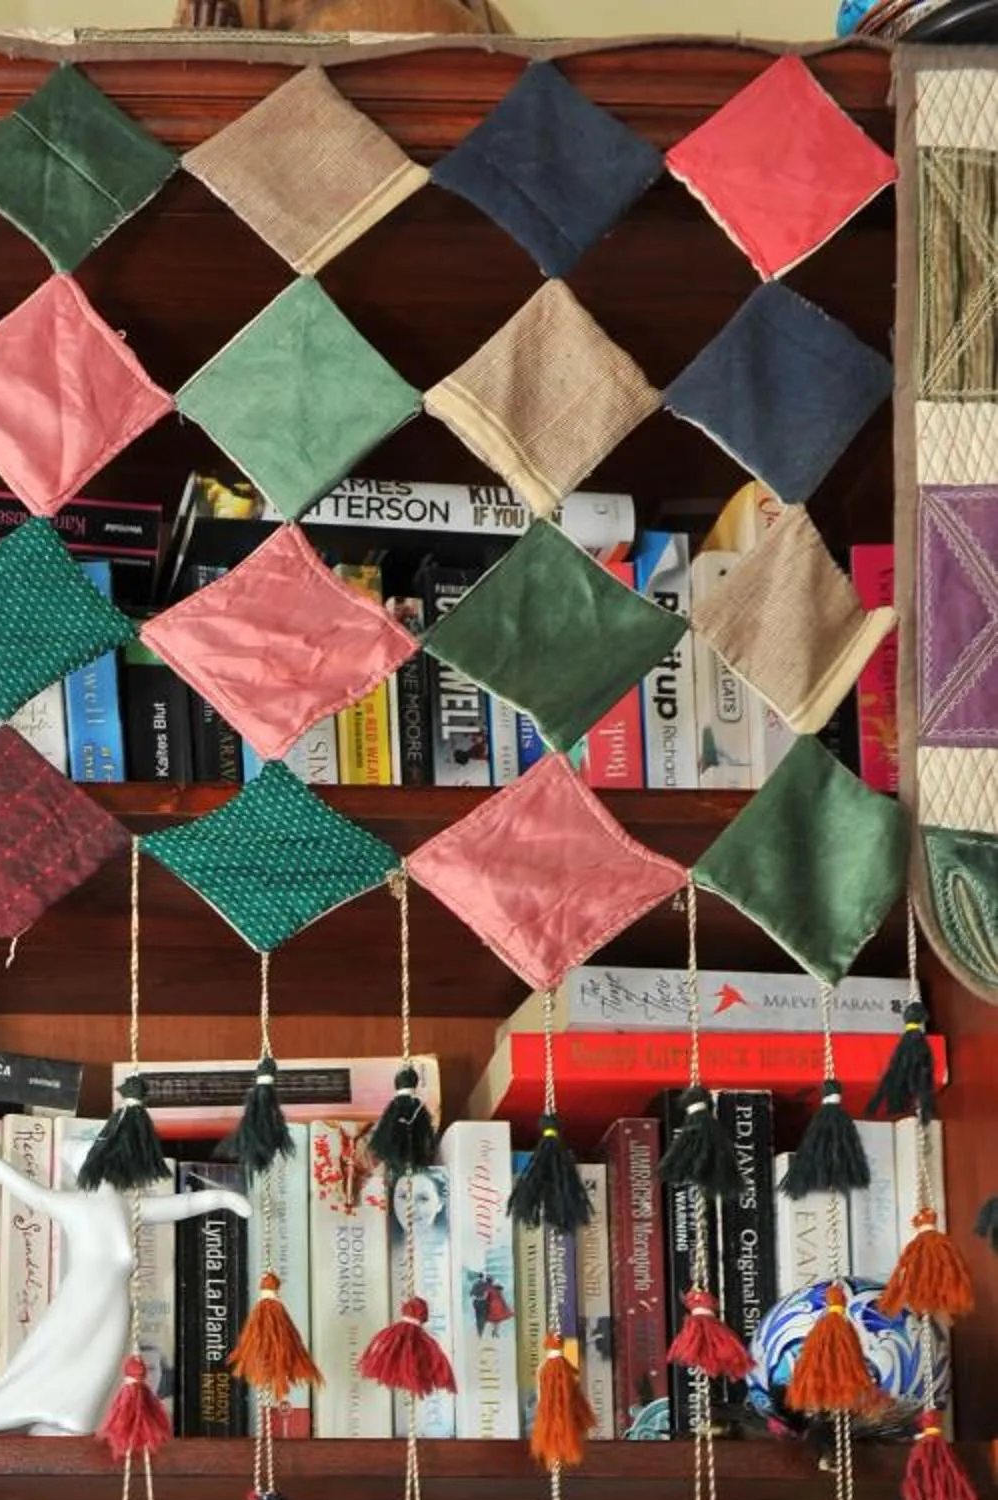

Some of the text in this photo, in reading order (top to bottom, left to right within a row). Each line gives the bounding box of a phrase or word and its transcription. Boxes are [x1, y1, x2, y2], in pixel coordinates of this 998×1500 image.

[469, 485, 521, 505] KILL
[473, 506, 490, 526] IF
[153, 702, 167, 729] Blut
[405, 694, 423, 761] MOORE
[600, 721, 627, 777] Book
[661, 725, 678, 786] Richard
[467, 1165, 501, 1245] affair
[627, 1140, 650, 1218] JAMRACH'S
[673, 1191, 688, 1252] WARNING
[201, 1221, 227, 1361] Lynda La Plante
[336, 1225, 351, 1316] KOOMSON
[350, 1226, 365, 1314] DOROTHY
[737, 1229, 760, 1304] Original
[215, 1372, 230, 1425] DEADLY
